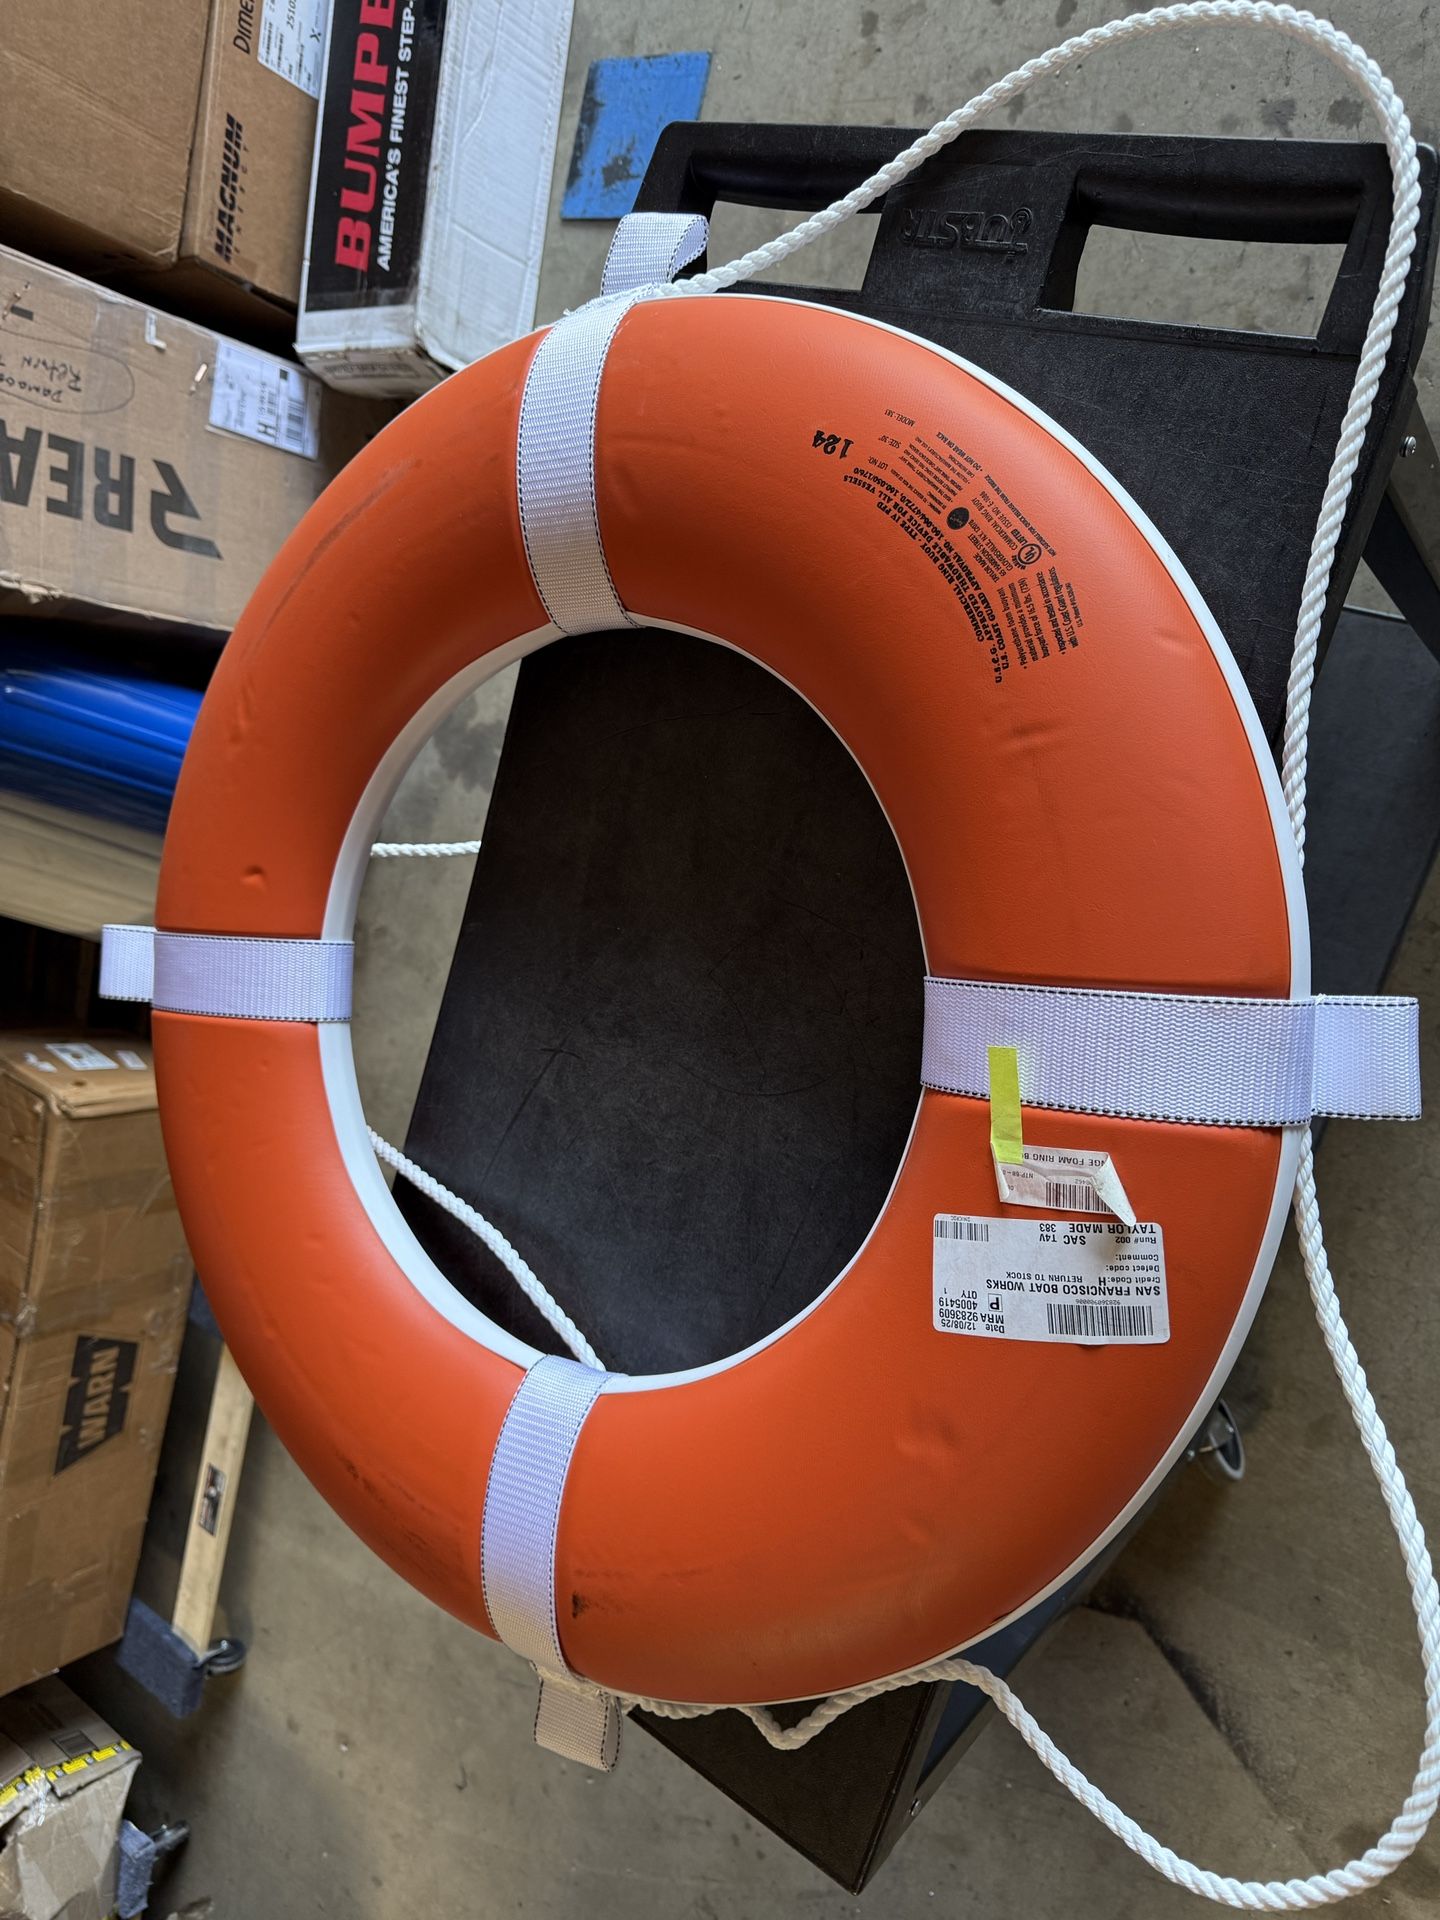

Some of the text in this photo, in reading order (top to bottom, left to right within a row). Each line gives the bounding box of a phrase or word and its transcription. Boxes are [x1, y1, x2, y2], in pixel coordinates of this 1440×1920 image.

[376, 148, 402, 272] AMERICA'S
[389, 67, 411, 143] FINEST
[214, 112, 243, 264] MAGNUM
[895, 413, 915, 427] MODEL:
[888, 438, 901, 449] SIZE:
[936, 432, 981, 471] DO NOT WEAR ON BACK
[877, 461, 888, 470] LOT
[843, 475, 875, 493] VESSELS
[853, 467, 899, 496] 160.050/176/0
[878, 490, 893, 503] ALL
[999, 493, 1010, 504] FROM
[893, 502, 907, 517] FOR
[1008, 503, 1022, 518] RELEASE
[907, 515, 933, 543] DEVICE
[971, 497, 1017, 550] COMMERCIAL RING BUOY
[998, 514, 1012, 528] ISSUE
[1018, 515, 1031, 528] QUICK
[1011, 529, 1027, 545] LISTED
[1028, 526, 1037, 535] FOR
[943, 540, 954, 553] NO.
[968, 533, 983, 550] STREET
[1034, 533, 1050, 549] SUITABLE
[1047, 547, 1057, 557] NOT
[932, 543, 968, 592] THROWABLE
[973, 553, 999, 582] TAYLOR MADE
[980, 548, 1001, 573] HARRISON
[876, 501, 984, 642] COMMERCIAL RING BUOY TYPE IV PFD
[953, 552, 981, 590] APPROVAL
[1036, 572, 1049, 598] accordance
[978, 592, 995, 621] GUARD
[1056, 594, 1067, 611] Guard
[968, 594, 993, 640] APPROVED
[1044, 603, 1056, 619] tested
[1061, 610, 1072, 626] Coast
[997, 587, 1027, 665] Polyurethane foam buoyant
[1018, 614, 1032, 637] provides
[1033, 621, 1043, 636] force
[1048, 618, 1059, 628] and
[1065, 625, 1075, 636] U.S.
[992, 623, 1005, 650] COAST
[1052, 628, 1066, 652] Inspected
[1068, 636, 1079, 648] with
[1025, 638, 1038, 661] material
[1037, 635, 1050, 658] buoyant
[990, 644, 1003, 683] U.S.C.G.
[1000, 652, 1009, 670] U.S.
[1032, 1154, 1054, 1162] RING
[1058, 1156, 1084, 1166] FOAM
[1039, 1223, 1155, 1233] TAYLOR MADE 383
[1039, 1233, 1056, 1242] T4V
[1063, 1235, 1086, 1245] SAC
[1006, 1271, 1031, 1280] STOCK
[1098, 1277, 1106, 1285] H
[961, 1290, 977, 1298] QTY
[986, 1279, 1160, 1295] SAN FRANCISCO BOAT WORKS
[939, 1297, 977, 1310] 4005419
[990, 1297, 999, 1310] P
[939, 1308, 1004, 1324] MRA 9283609
[941, 1318, 1004, 1333] Date 12/08/25
[77, 1346, 120, 1450] WARN
